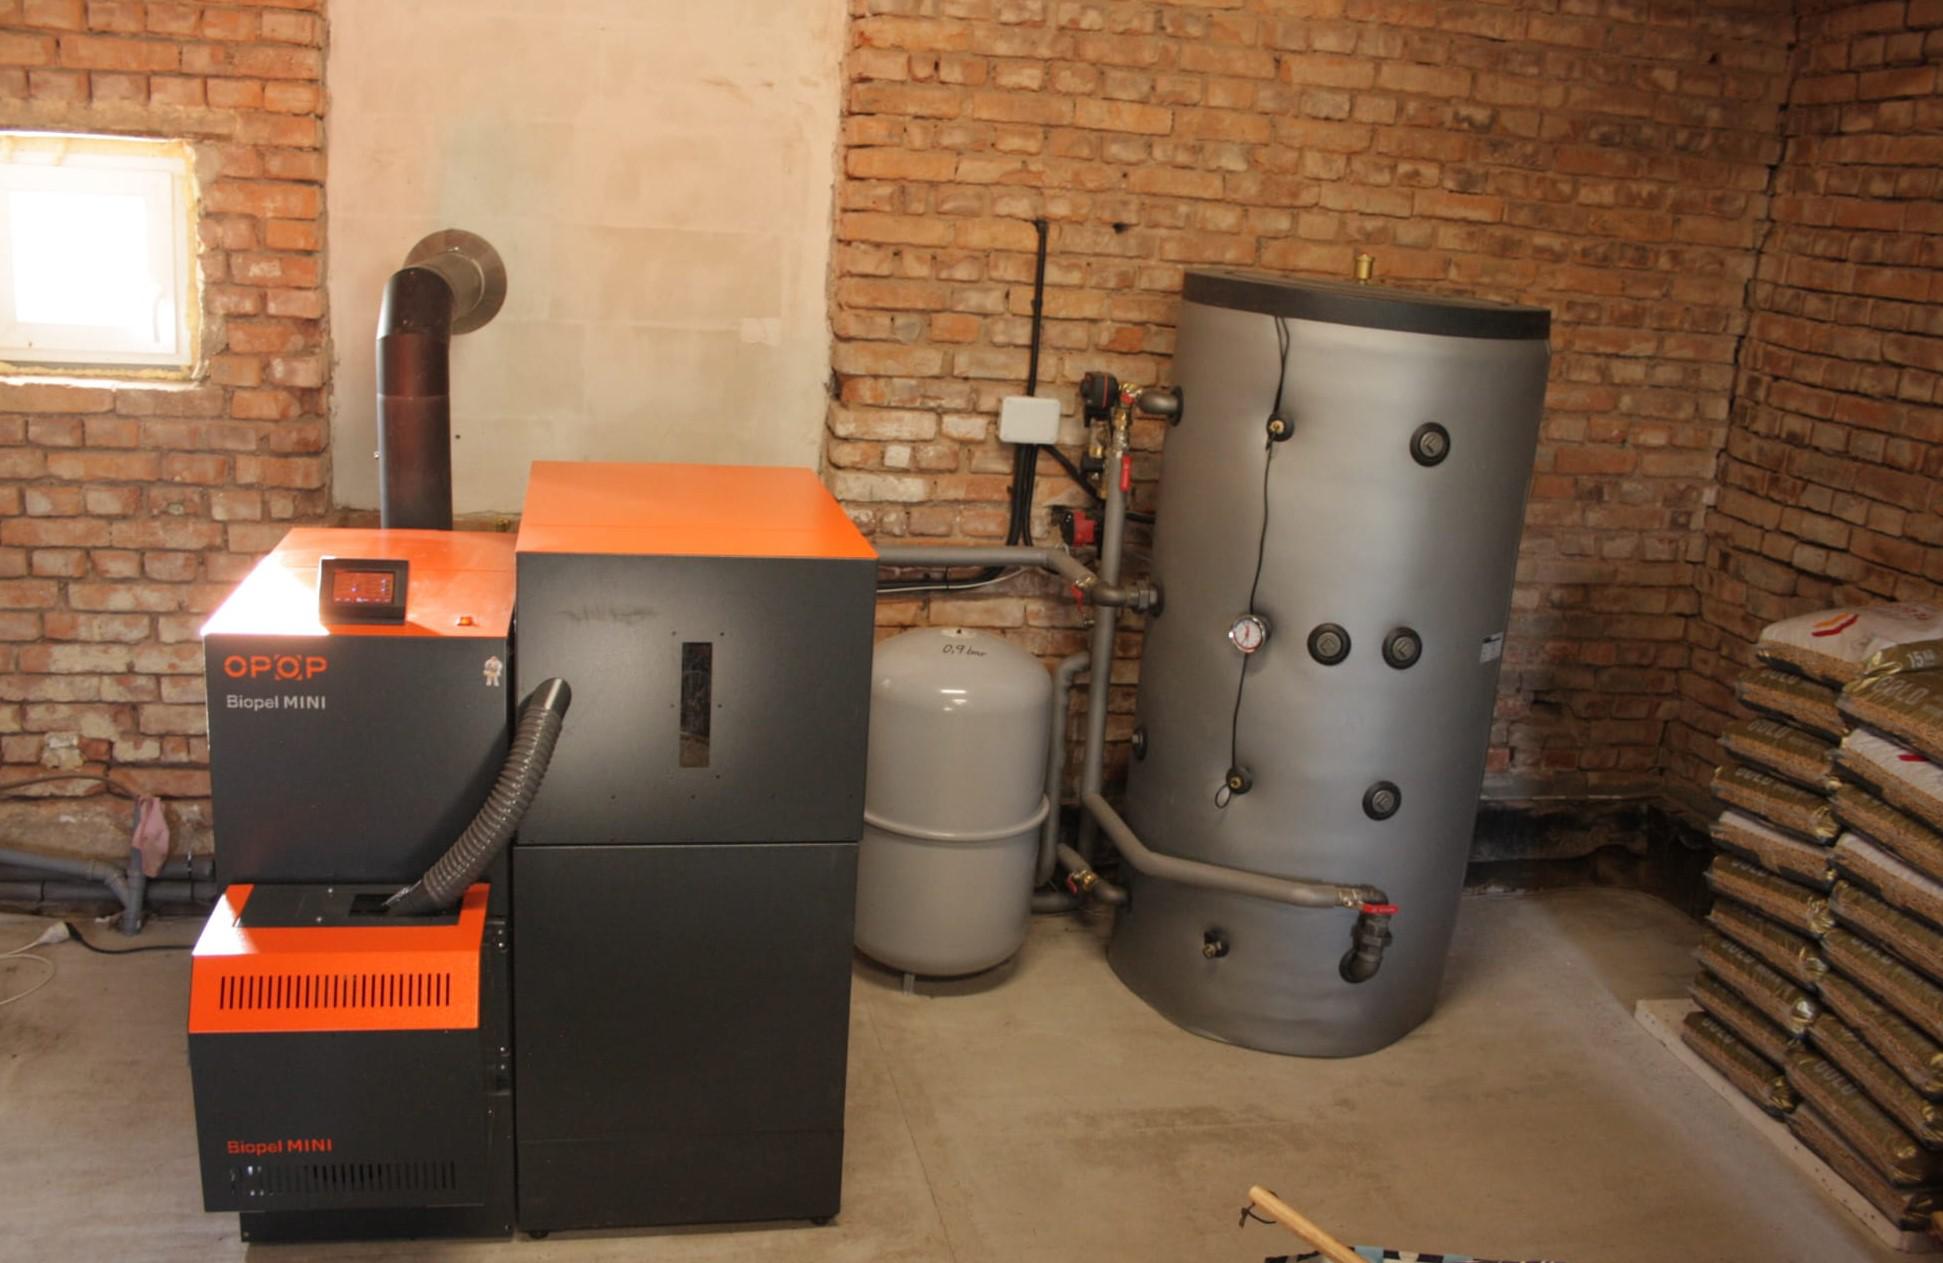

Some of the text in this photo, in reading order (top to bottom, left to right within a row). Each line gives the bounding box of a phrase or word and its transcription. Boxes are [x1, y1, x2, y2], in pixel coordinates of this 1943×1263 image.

[223, 655, 328, 680] OPOP
[226, 694, 326, 712] Biopel MINI
[226, 1138, 332, 1157] Biopel MINI
